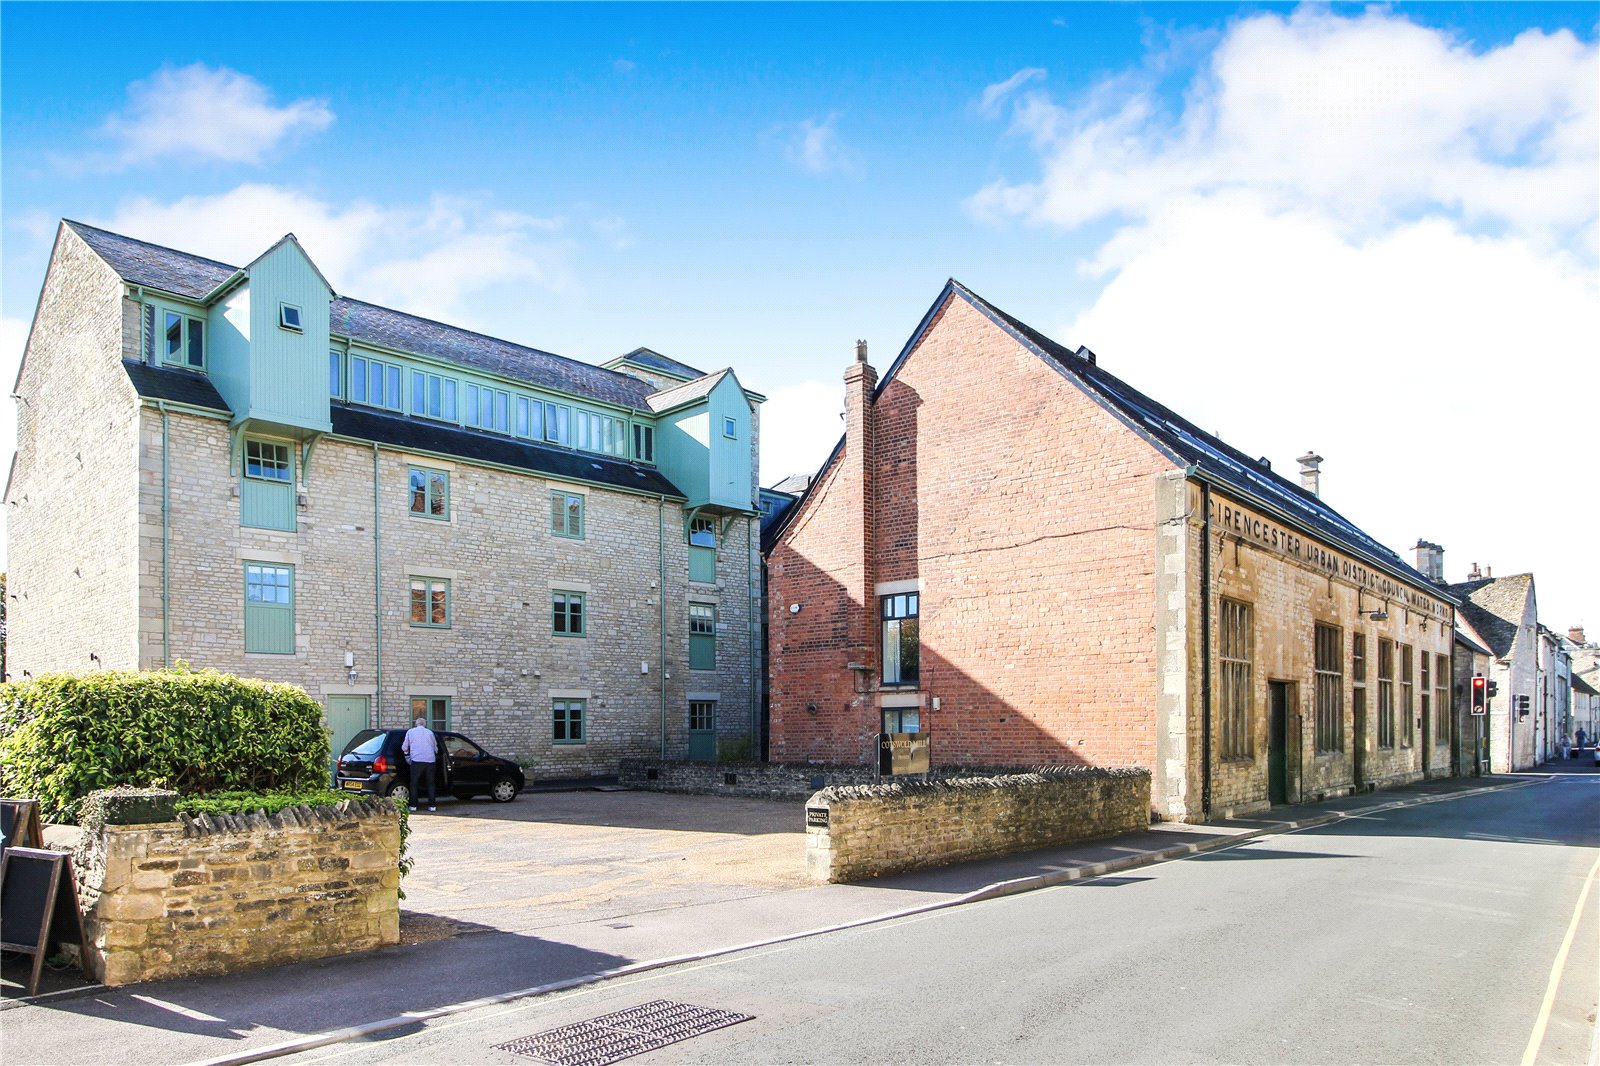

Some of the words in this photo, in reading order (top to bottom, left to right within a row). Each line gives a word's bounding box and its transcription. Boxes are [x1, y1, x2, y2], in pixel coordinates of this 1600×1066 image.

[1307, 544, 1339, 573] URBAN
[1343, 561, 1379, 590] DISTRICT
[1411, 592, 1430, 611] WATER
[881, 740, 911, 749] COTSWOLD
[912, 739, 926, 748] MILL
